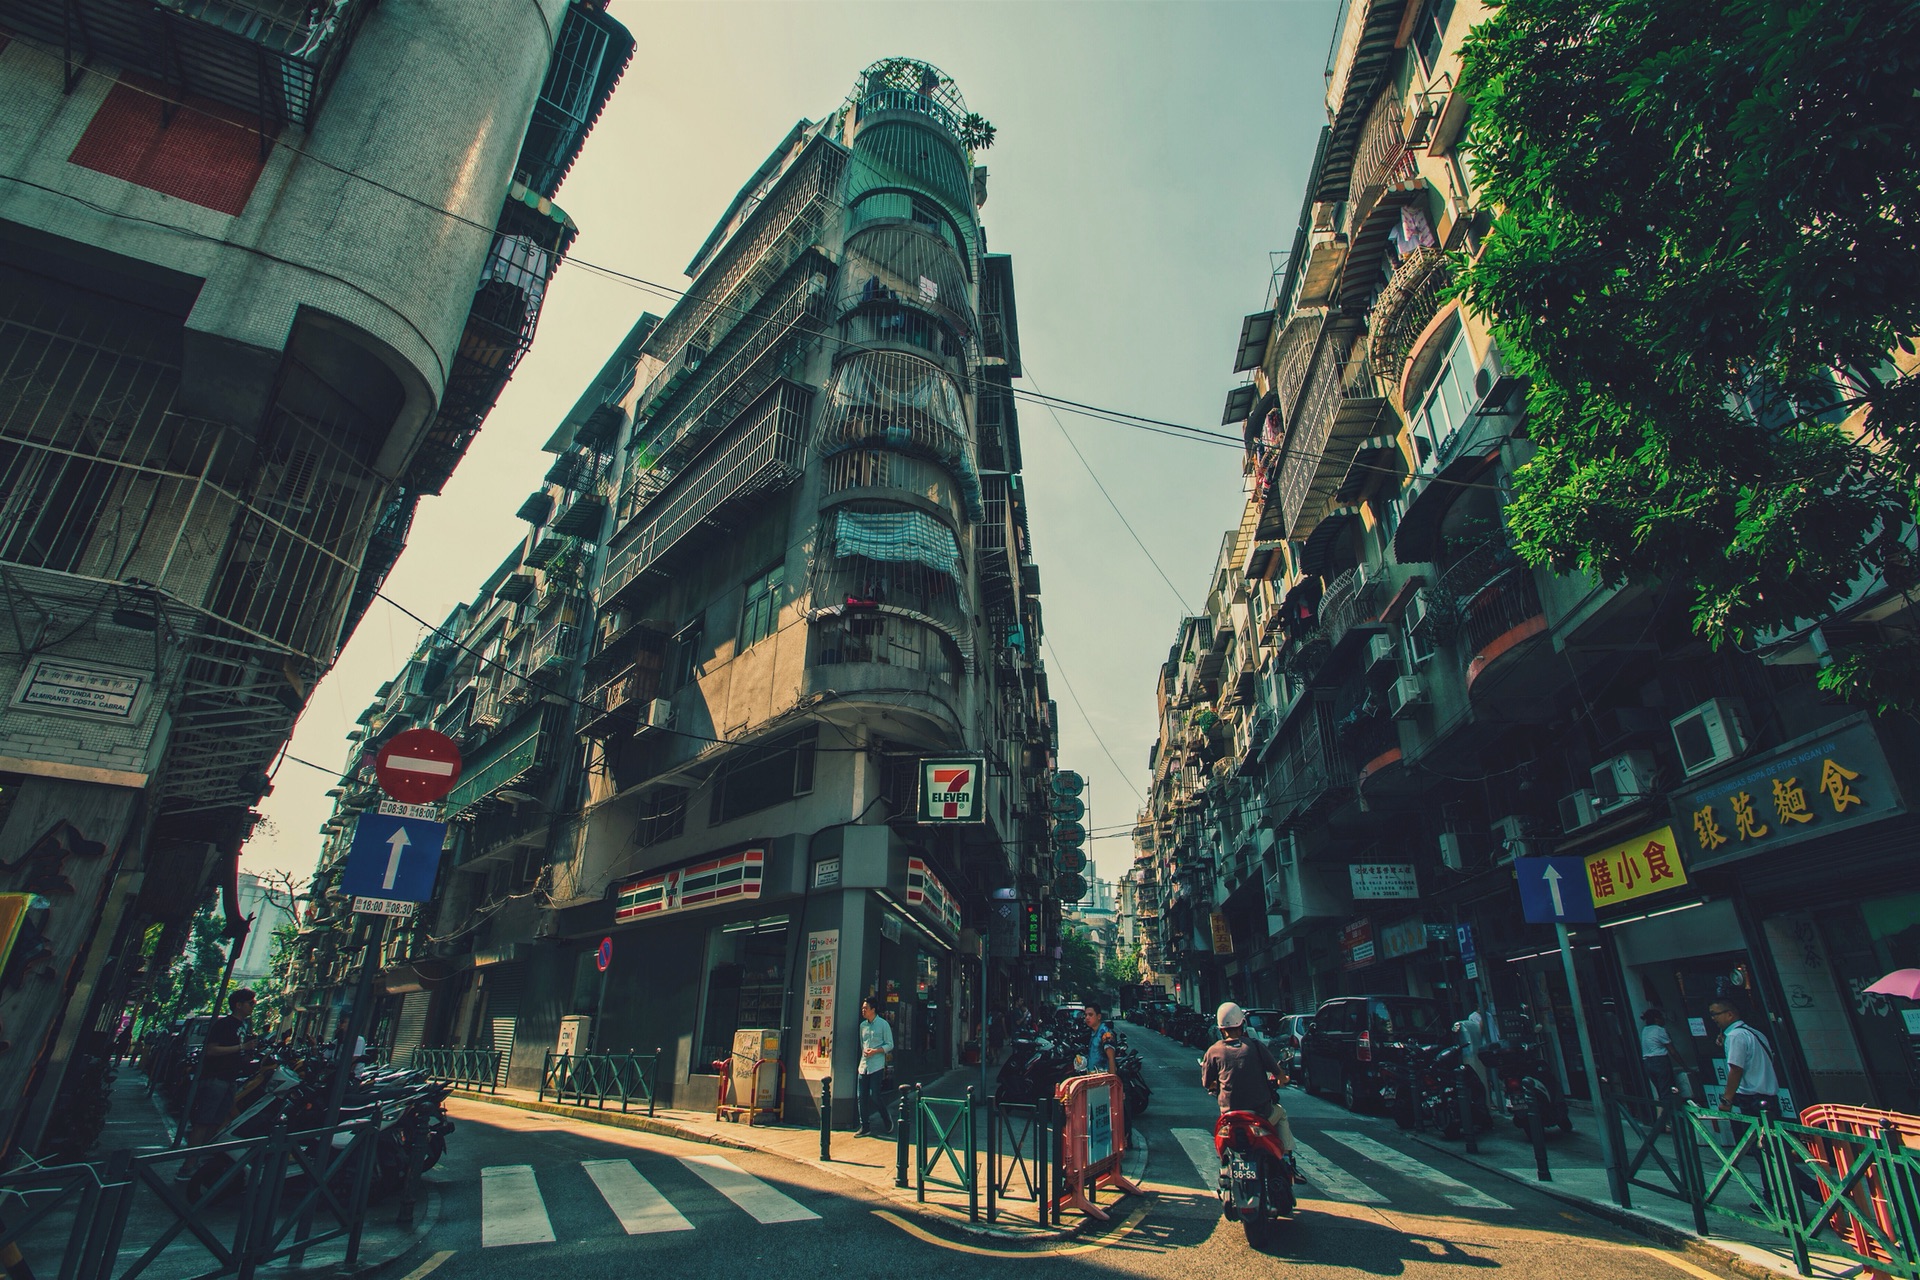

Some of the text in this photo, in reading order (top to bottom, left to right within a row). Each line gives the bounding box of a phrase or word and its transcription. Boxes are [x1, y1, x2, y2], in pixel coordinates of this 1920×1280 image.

[29, 692, 126, 711] ALMIRANTE COSTA CABRAL
[58, 688, 92, 699] ROTUNDA
[1747, 771, 1766, 785] SOPA
[1766, 764, 1777, 776] DE
[1777, 756, 1798, 771] FITAS
[1798, 749, 1823, 763] NGAN
[1823, 743, 1836, 754] UN
[934, 769, 970, 818] 7
[1693, 759, 1862, 850] 銀苑麵食
[387, 803, 408, 815] 08:30
[415, 807, 435, 819] 18:00
[1589, 840, 1674, 898] 膳小食
[362, 899, 383, 912] 18:00
[391, 903, 412, 915] 08:30
[1457, 927, 1467, 953] P
[1233, 1170, 1256, 1179] 36-53
